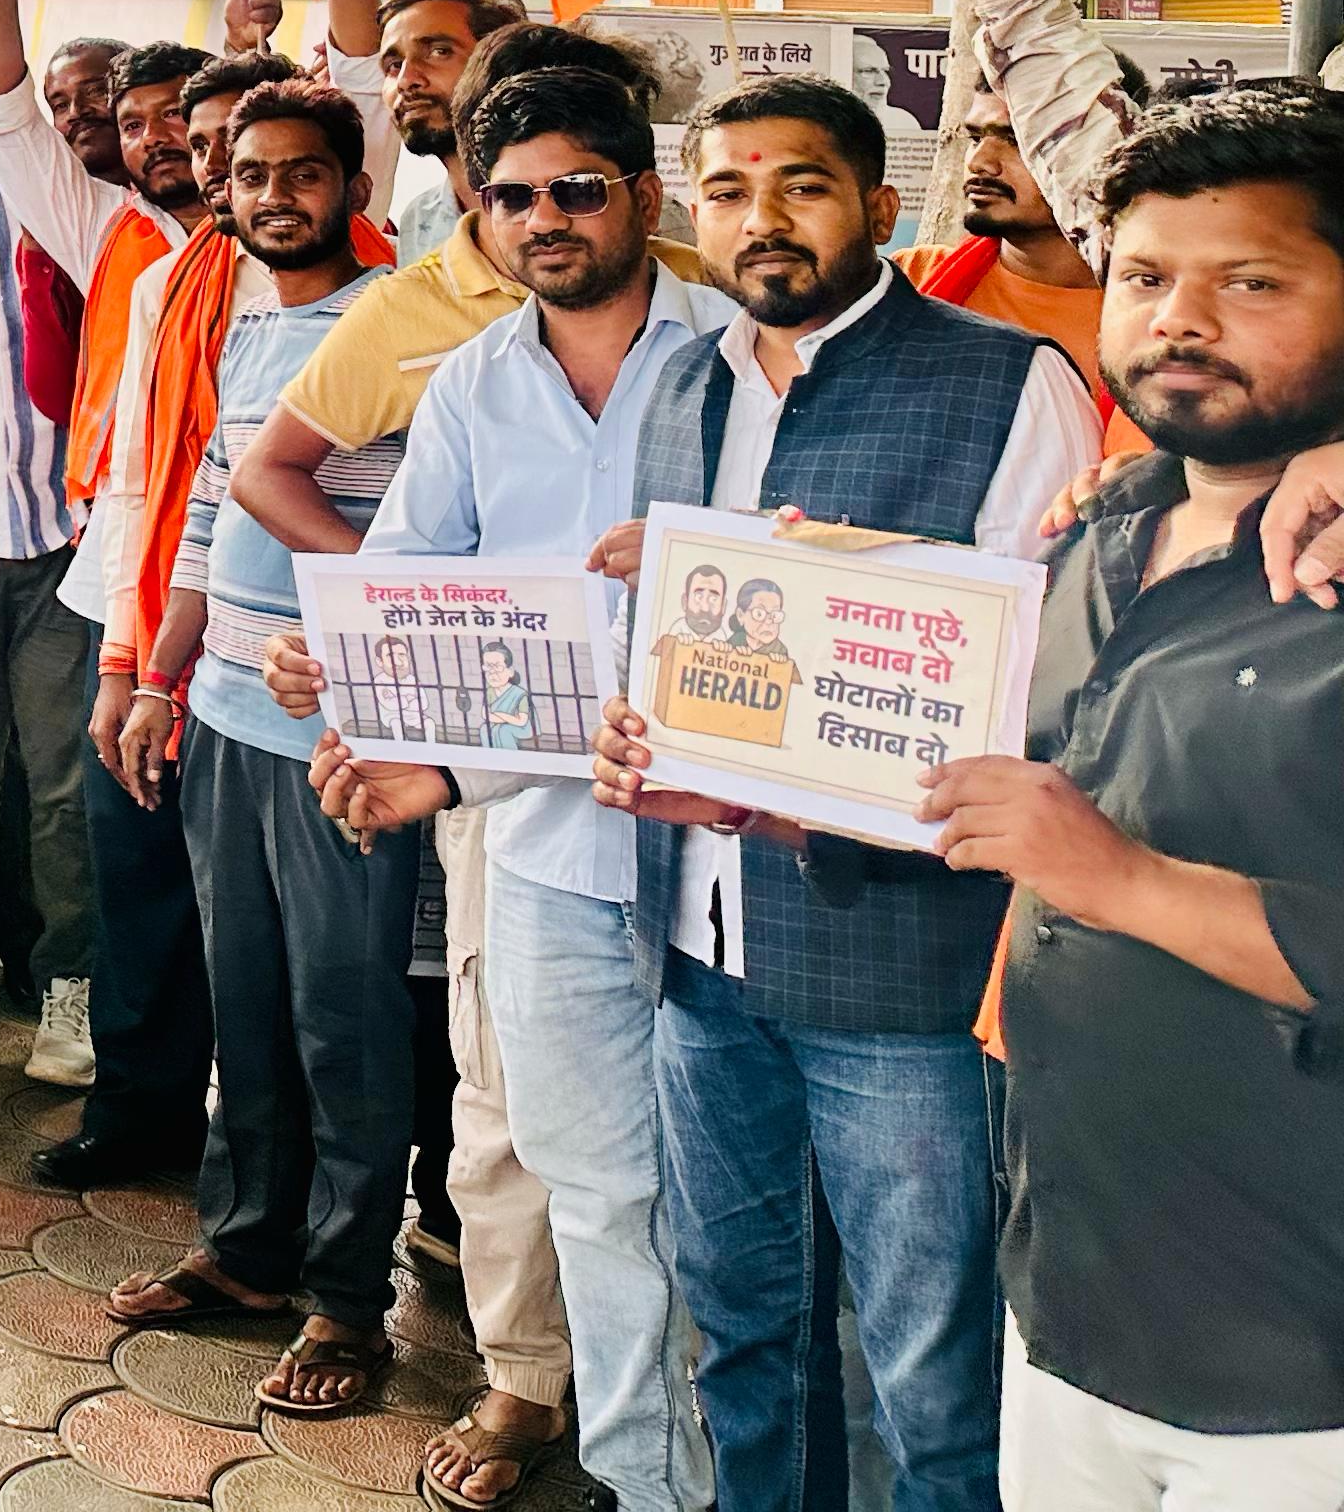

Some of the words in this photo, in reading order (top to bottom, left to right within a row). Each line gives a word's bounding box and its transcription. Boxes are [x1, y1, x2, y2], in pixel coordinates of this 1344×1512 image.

[761, 42, 778, 62] के
[780, 42, 812, 63] लिये
[364, 582, 416, 604] हेराल्ड
[419, 582, 439, 603] के
[443, 583, 514, 605] सिकंदर,
[382, 604, 422, 629] होंगे
[427, 605, 467, 628] जेल
[470, 604, 497, 628] के
[501, 606, 548, 631] अंदर
[825, 595, 904, 635] जनता
[912, 607, 968, 650] पूछे,
[691, 648, 770, 681] National
[831, 637, 915, 676] जवाब
[921, 648, 955, 683] दो
[678, 664, 784, 712] HERALD
[812, 670, 916, 718] घोटालों
[920, 696, 965, 728] का
[816, 710, 910, 758] हिसाब
[915, 731, 950, 769] दो
